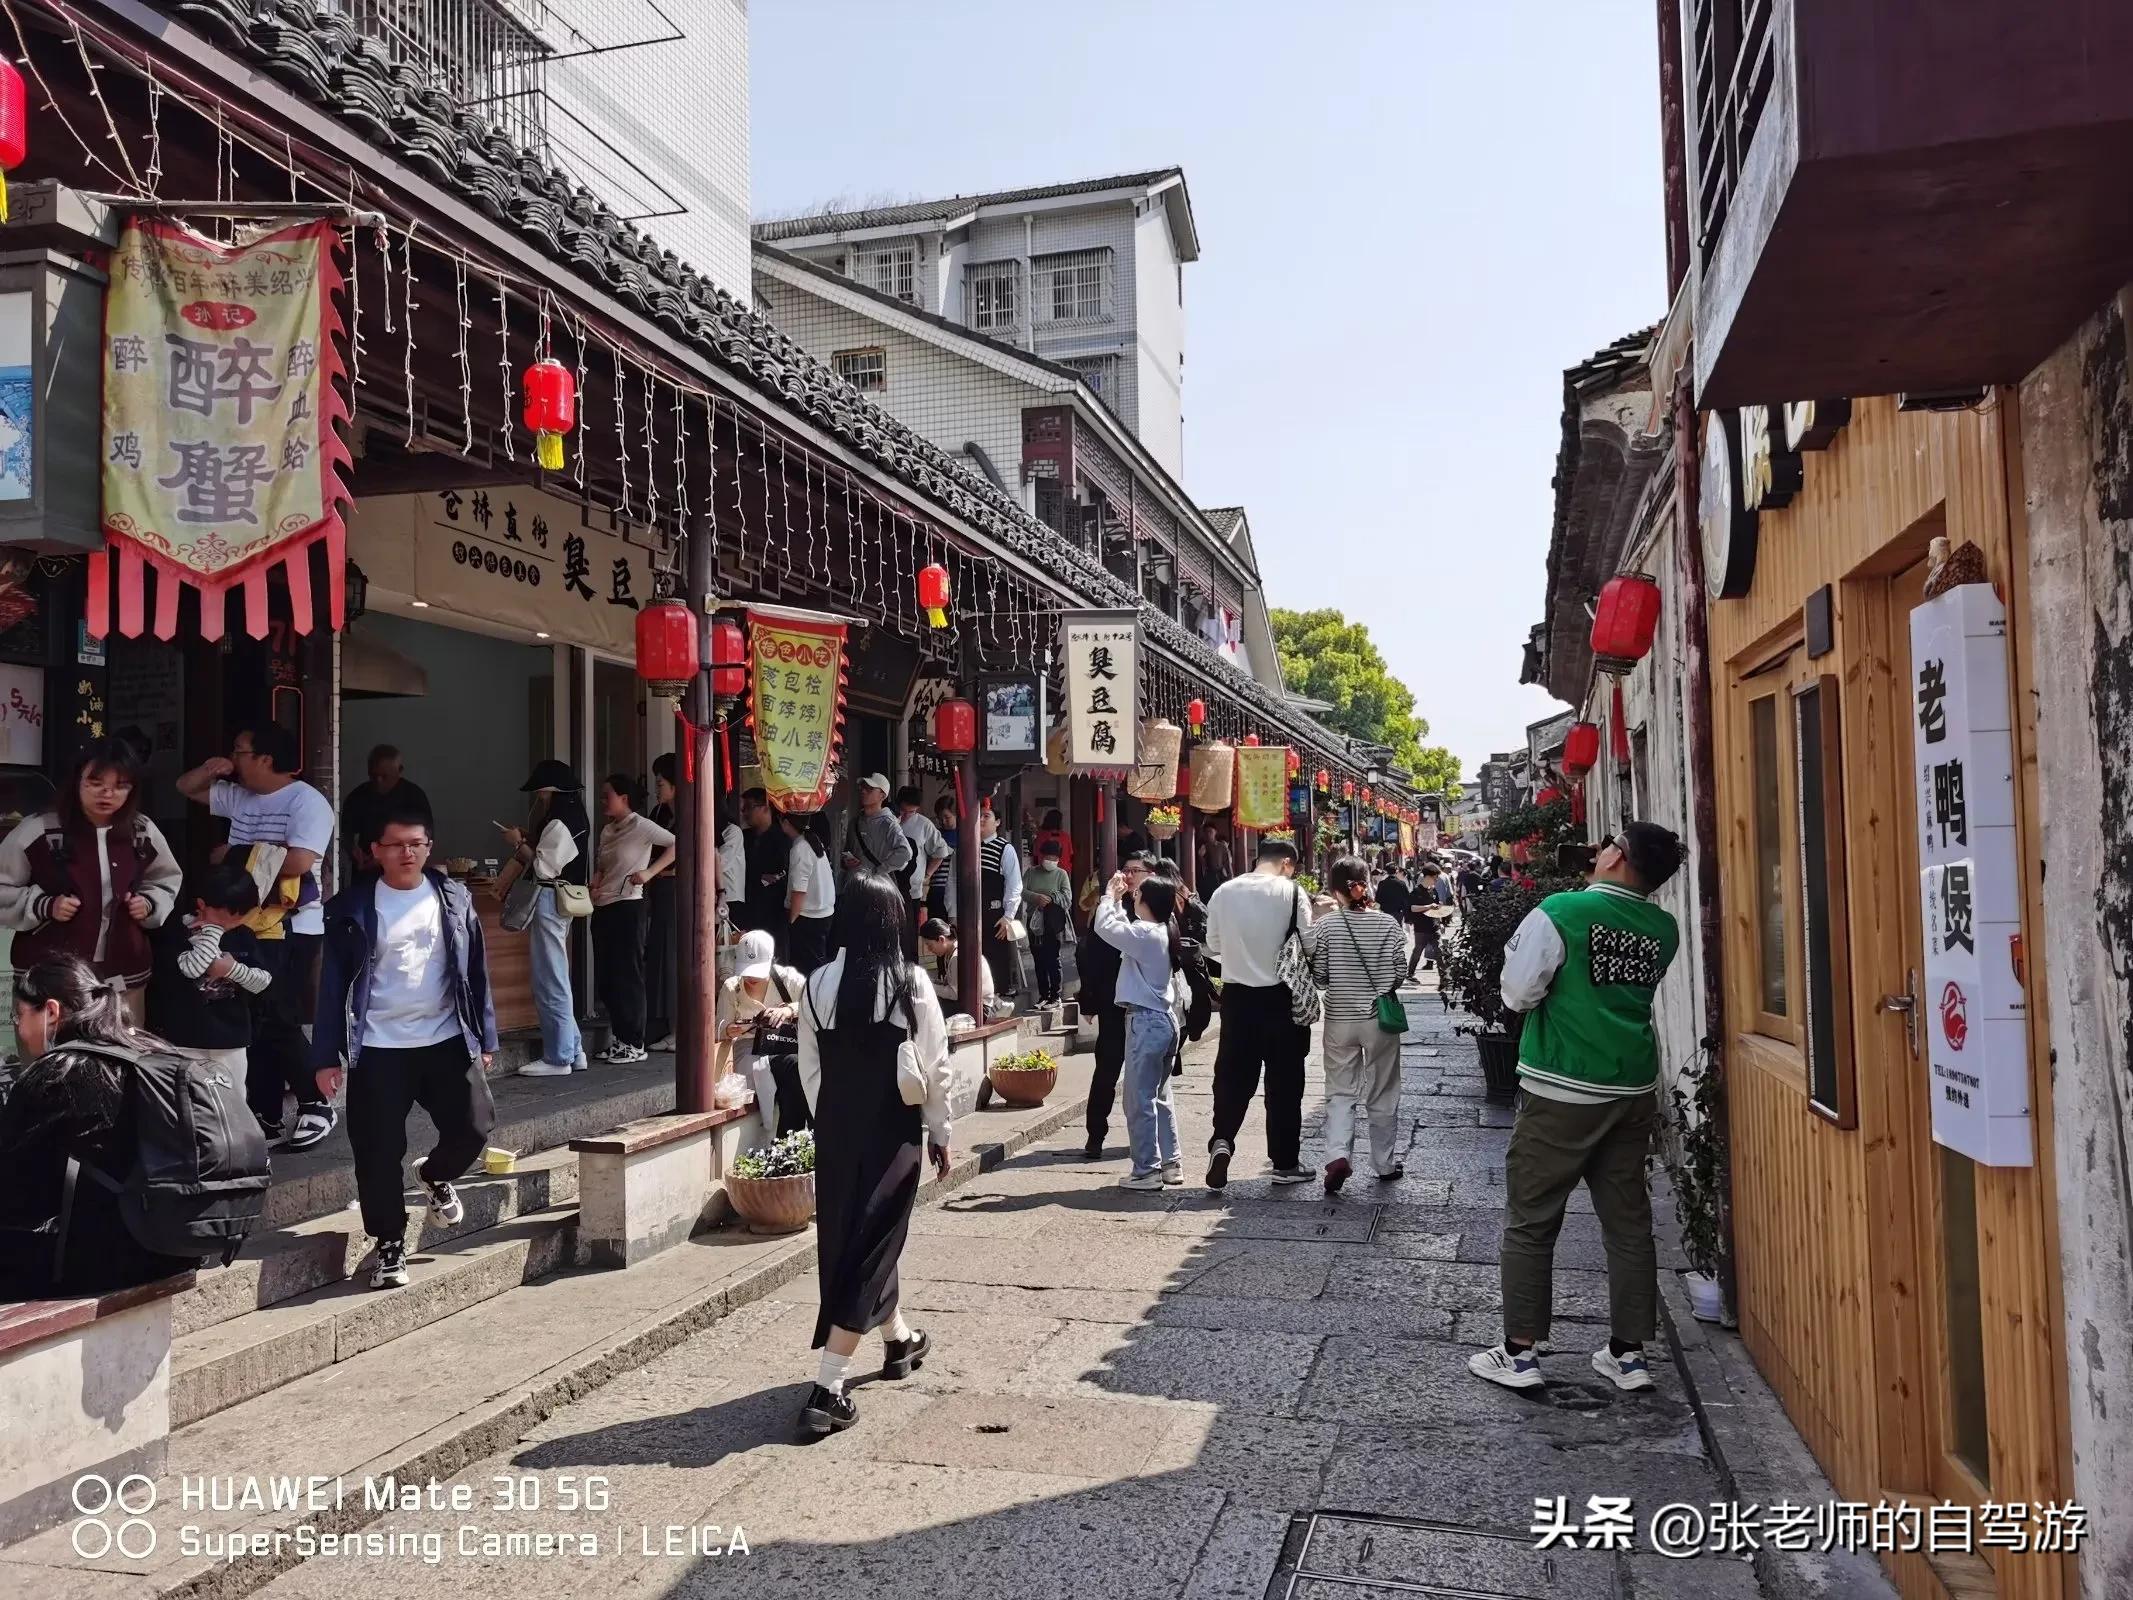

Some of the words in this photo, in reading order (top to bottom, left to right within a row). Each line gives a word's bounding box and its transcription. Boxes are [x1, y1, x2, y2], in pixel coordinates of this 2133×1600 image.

[194, 307, 246, 325] 孙记
[110, 335, 148, 469] 醉鸡
[157, 333, 282, 524] 醉蟹
[759, 637, 831, 669] 特色小吃
[1086, 646, 1119, 755] 臭豆腐
[1918, 657, 1975, 956] 老鸭煲
